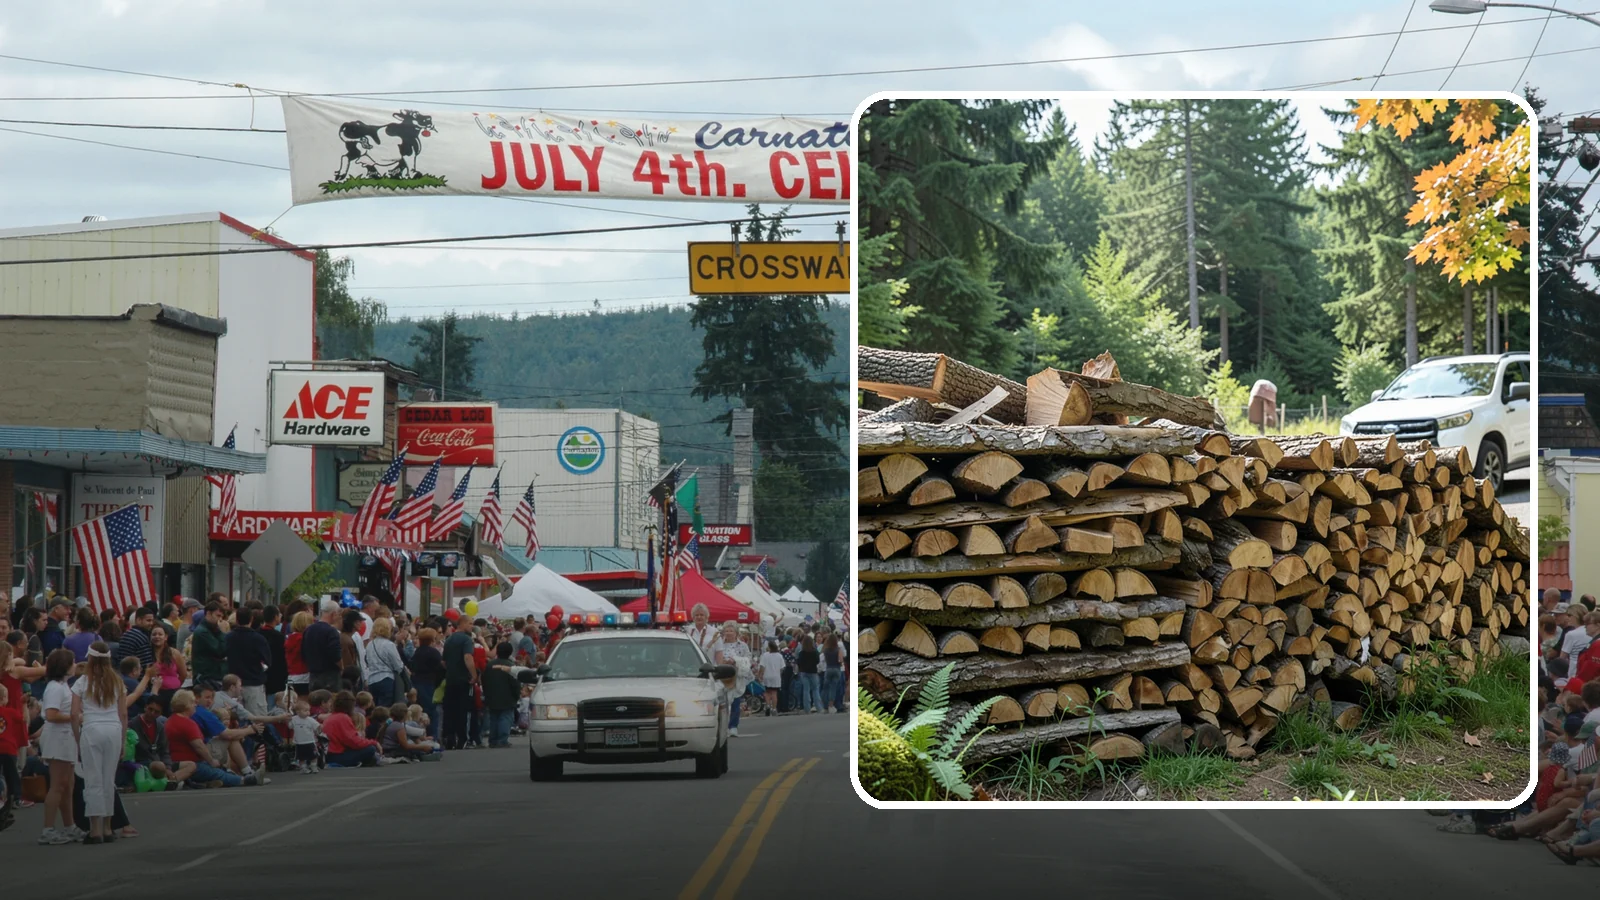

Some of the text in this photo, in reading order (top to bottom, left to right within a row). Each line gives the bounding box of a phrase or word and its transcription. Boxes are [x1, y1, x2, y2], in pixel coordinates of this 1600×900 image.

[481, 141, 605, 192] JULY
[632, 150, 746, 197] 4th.
[697, 254, 850, 280] CROSSWA
[283, 379, 373, 420] ACE
[405, 409, 485, 422] CEDAR LOG
[283, 421, 371, 437] Hardware
[416, 427, 477, 447] Coca-Cola
[353, 466, 386, 478] Simpl
[83, 484, 155, 496] St. Vincent de Paul
[80, 503, 154, 522] THT
[688, 526, 741, 535] CRNATION
[699, 535, 730, 543] GLASS
